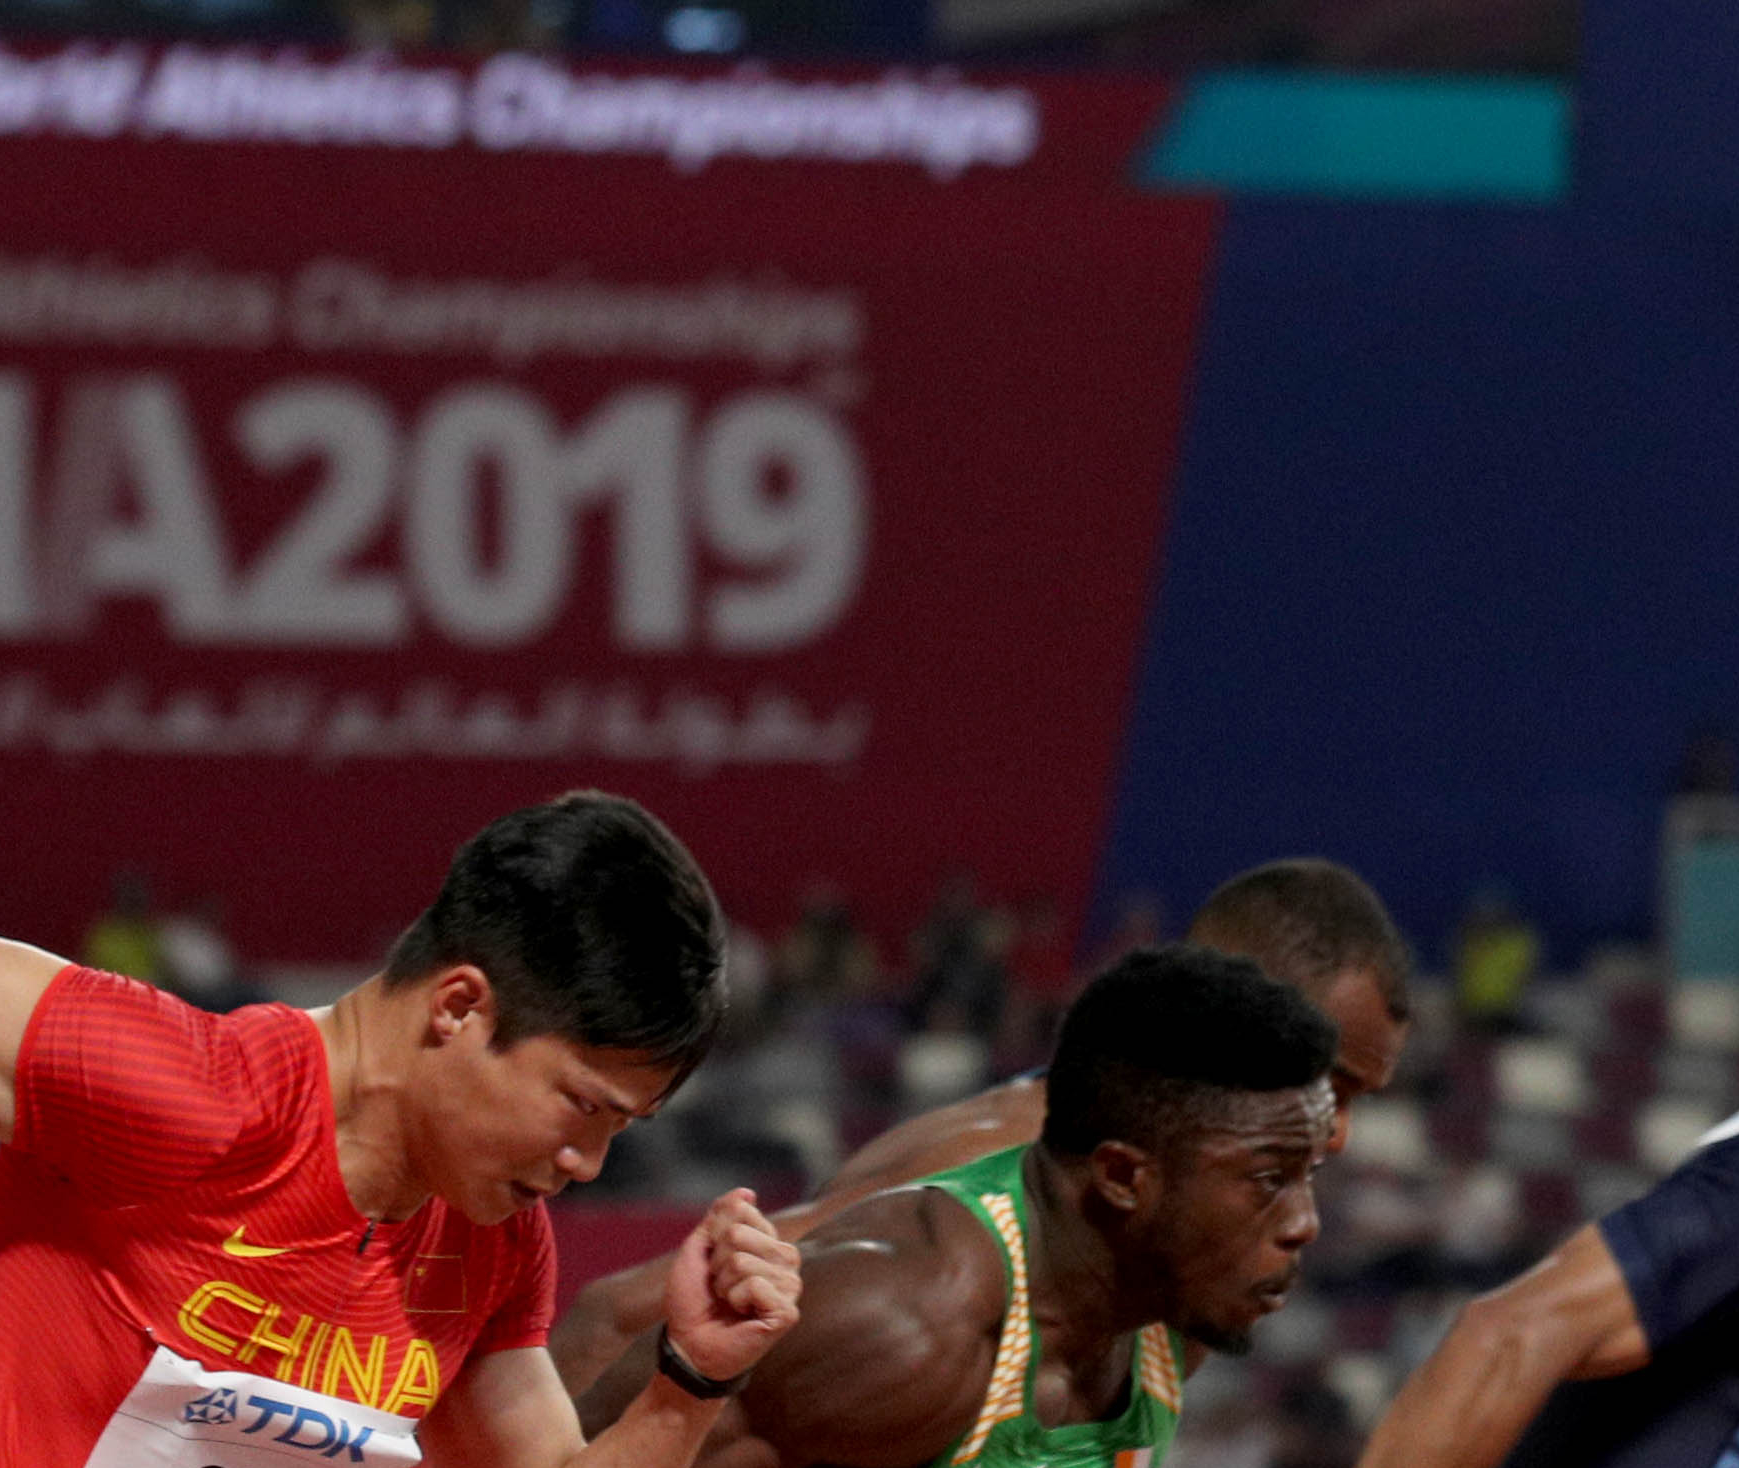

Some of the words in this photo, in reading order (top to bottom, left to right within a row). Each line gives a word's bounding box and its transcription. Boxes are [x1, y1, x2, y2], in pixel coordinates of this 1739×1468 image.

[143, 44, 463, 148] Athletics
[469, 52, 1039, 180] Championships
[283, 258, 867, 370] Championships
[178, 1281, 440, 1416] CHINA
[242, 1395, 375, 1463] TDK
